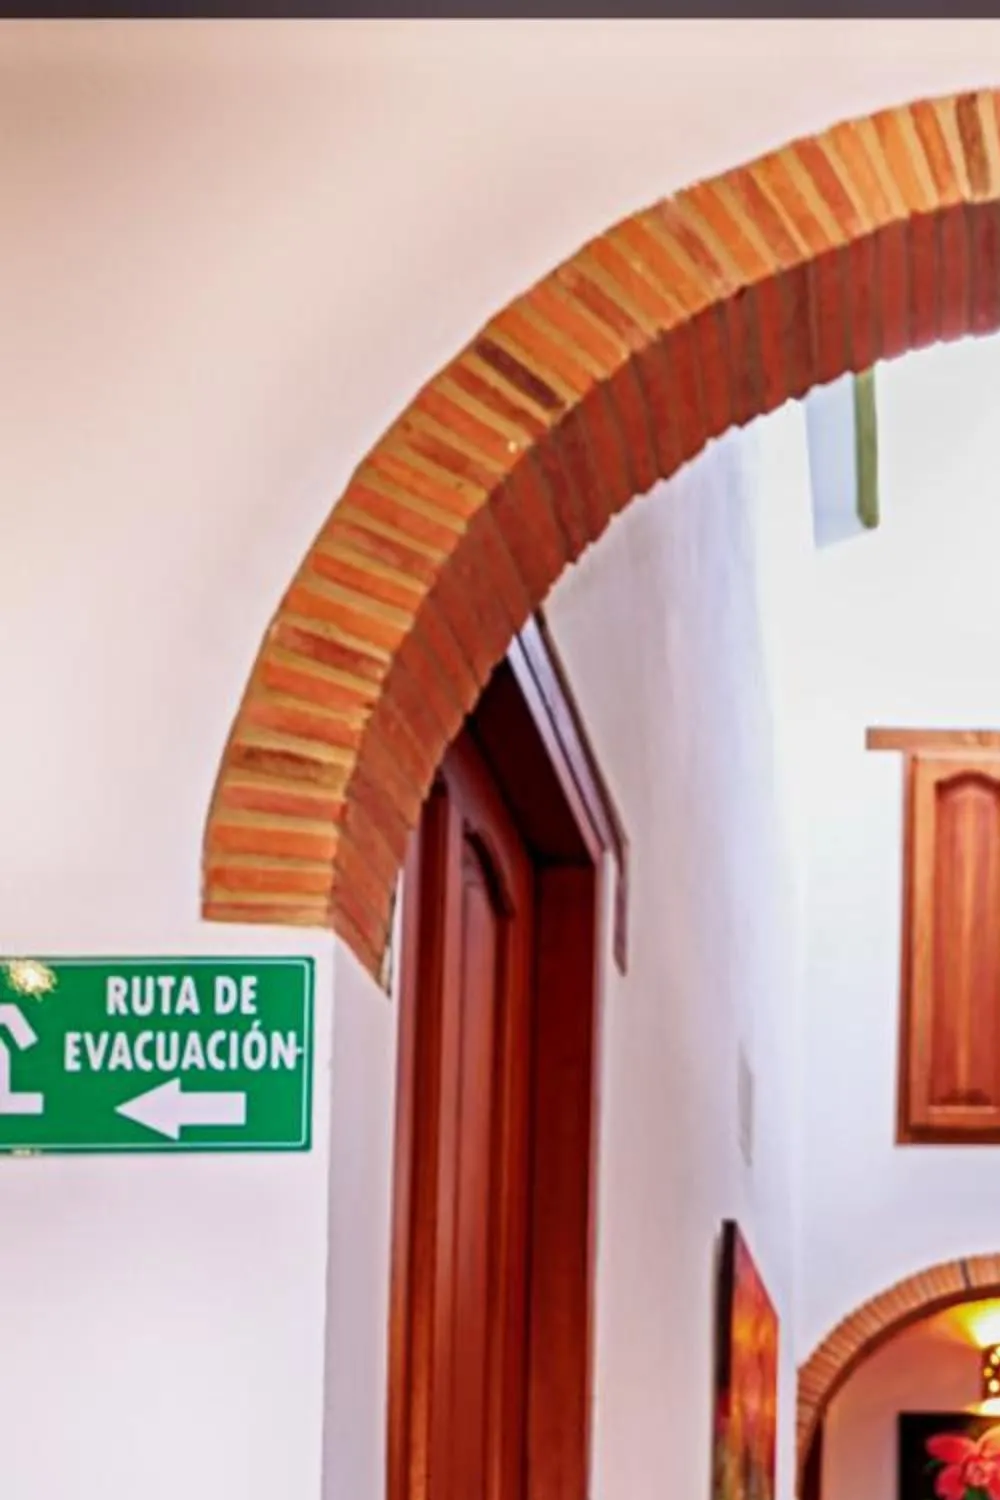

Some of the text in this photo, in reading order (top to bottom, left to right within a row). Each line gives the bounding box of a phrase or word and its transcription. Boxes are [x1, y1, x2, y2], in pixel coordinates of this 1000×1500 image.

[106, 975, 258, 1016] RUTA DE
[64, 1019, 298, 1072] EVACUACIÓN
